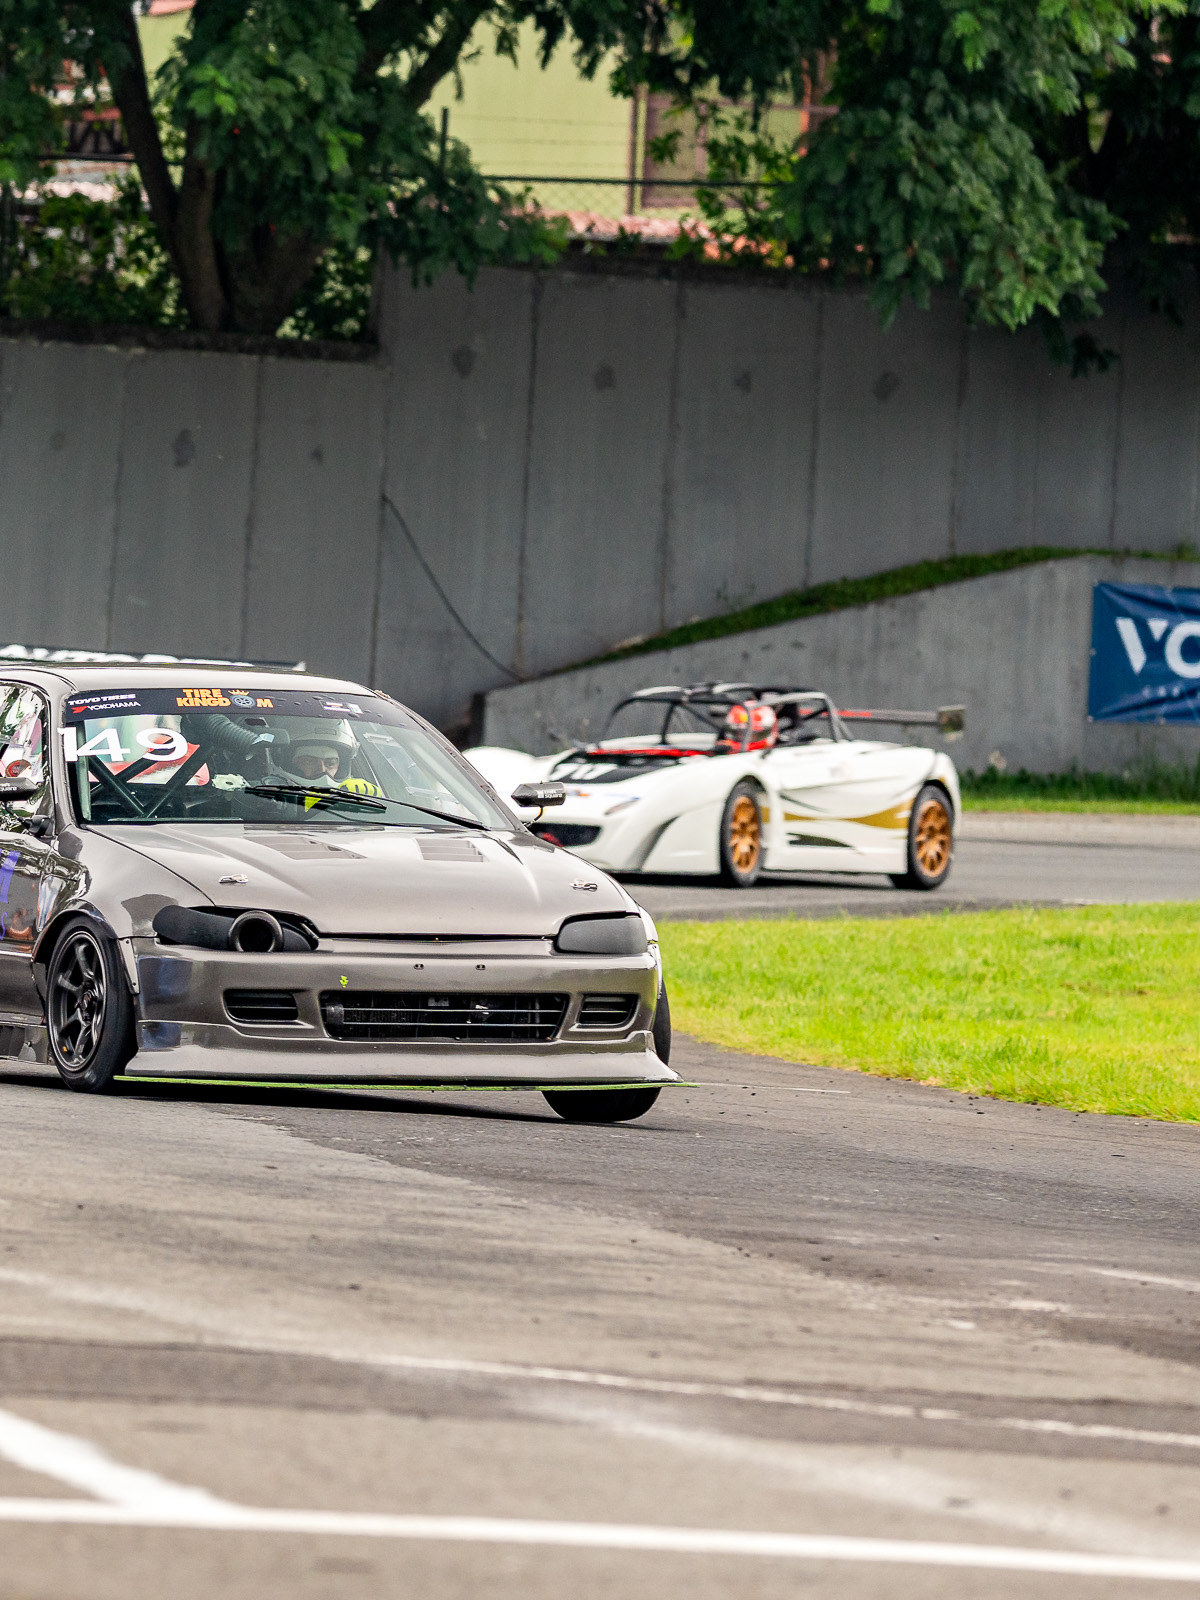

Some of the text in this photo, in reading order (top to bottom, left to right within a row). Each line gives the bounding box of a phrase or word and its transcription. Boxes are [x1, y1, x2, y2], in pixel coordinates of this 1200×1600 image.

[182, 688, 222, 698] TIRE
[67, 693, 136, 706] TOYO TIRES
[86, 701, 141, 711] YOKOHAMA
[57, 726, 188, 762] 149
